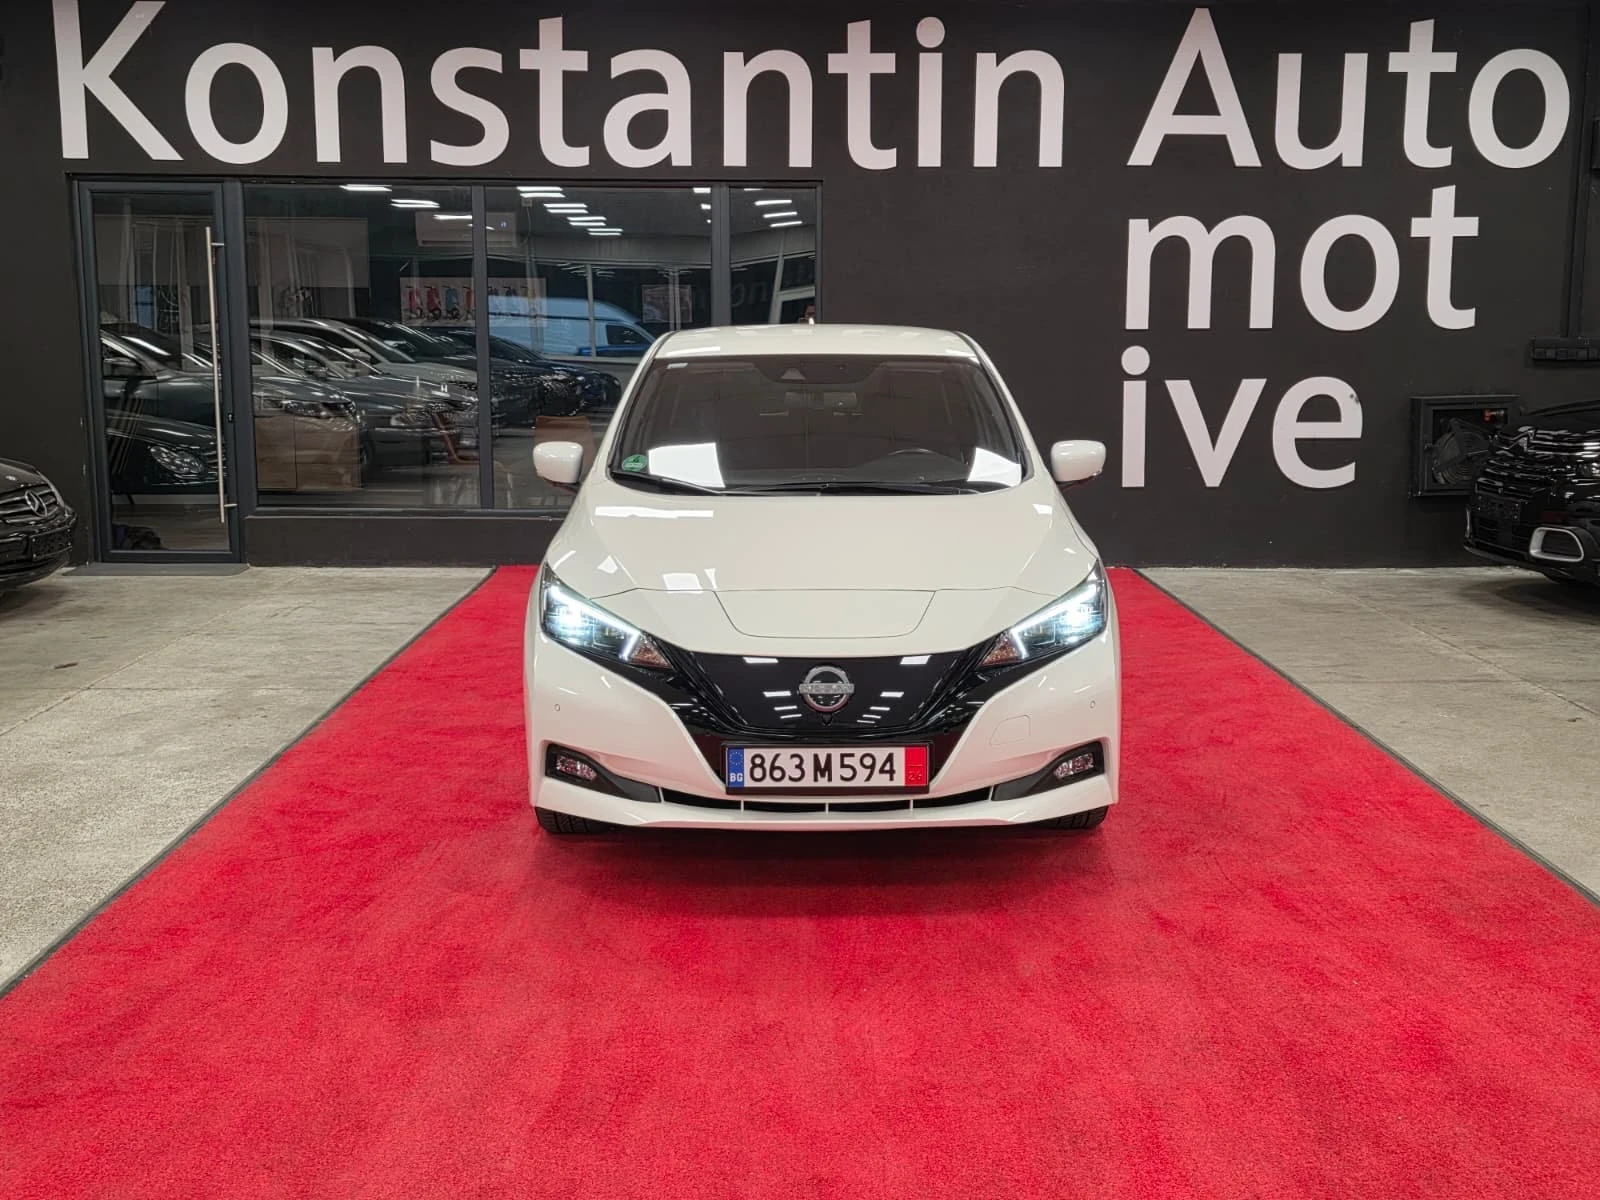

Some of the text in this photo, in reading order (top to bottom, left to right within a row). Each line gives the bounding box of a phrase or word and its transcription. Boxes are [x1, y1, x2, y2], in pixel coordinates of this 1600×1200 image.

[52, 0, 1570, 169] Konstantin Auto
[1125, 185, 1479, 330] mot
[1121, 345, 1363, 488] ive
[729, 772, 743, 782] BG
